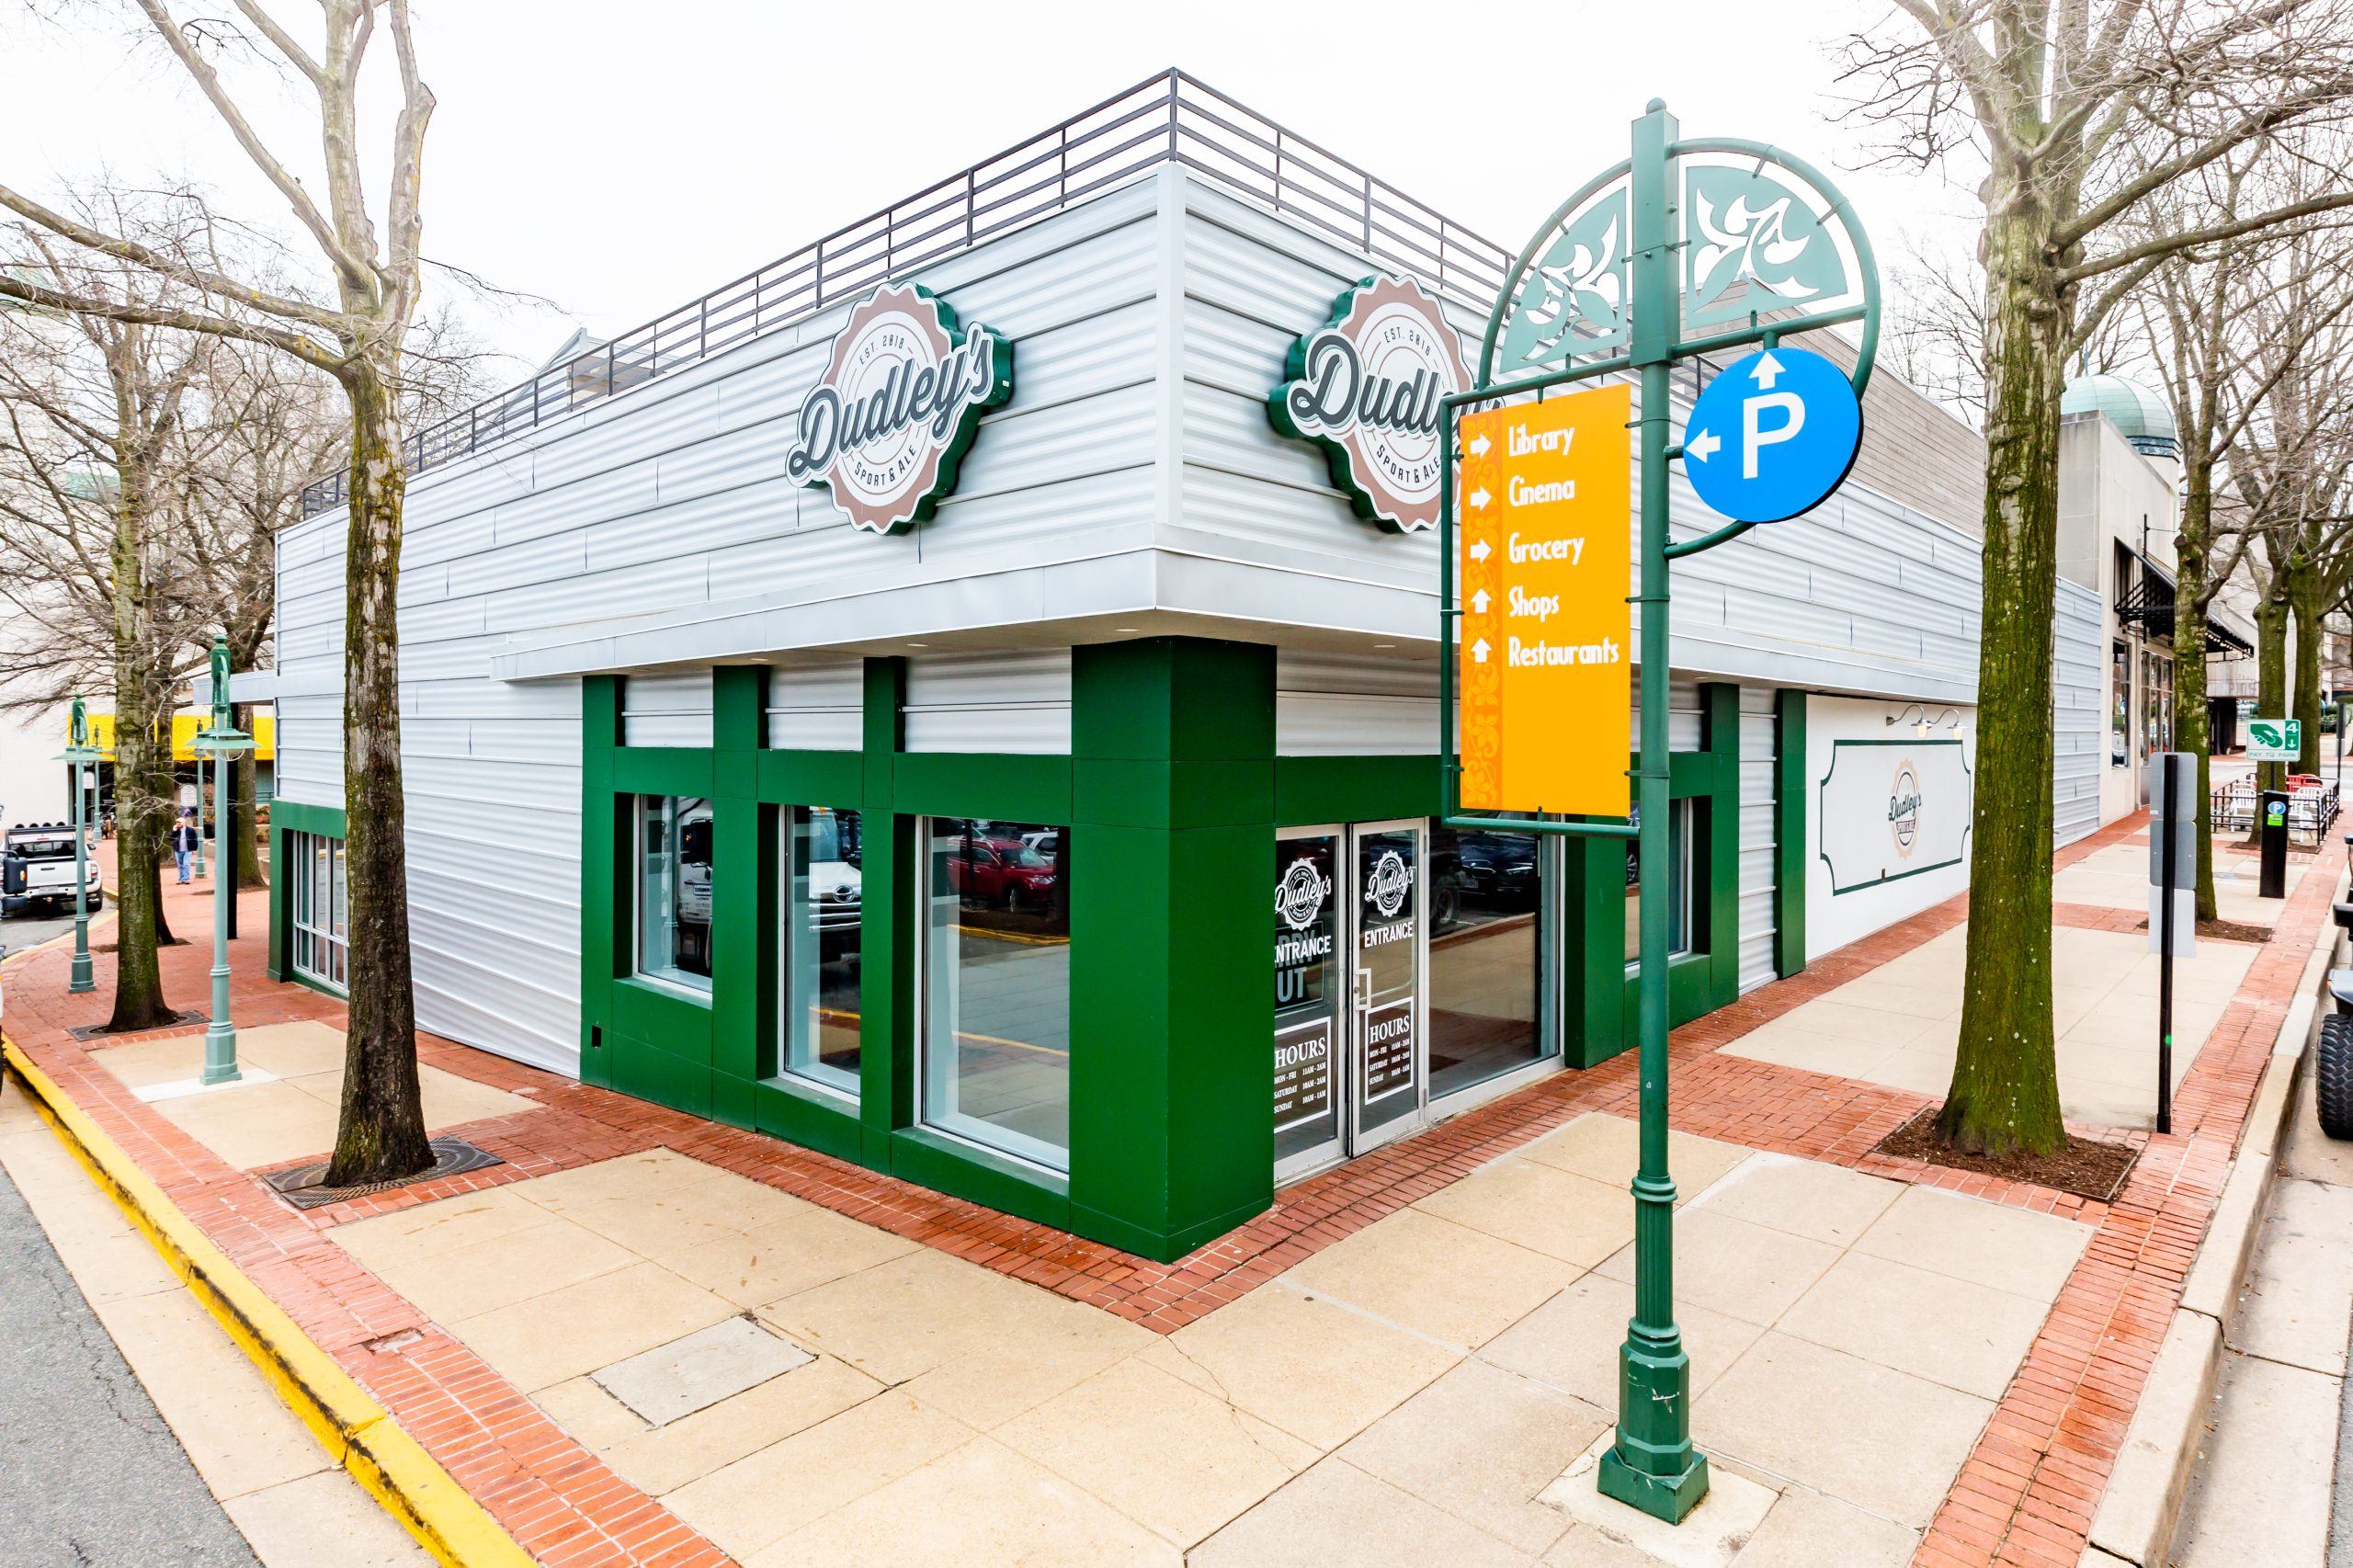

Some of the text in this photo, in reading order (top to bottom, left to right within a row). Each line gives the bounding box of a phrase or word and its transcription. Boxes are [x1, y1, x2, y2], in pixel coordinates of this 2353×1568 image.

[1383, 326, 1404, 344] EST.
[858, 343, 879, 365] EST.
[789, 329, 990, 476] Dudley's
[1508, 423, 1575, 457] Library
[1743, 391, 1806, 480] P
[854, 444, 916, 487] SPORT & ALE
[1376, 444, 1440, 484] SPORT & ALE
[1508, 475, 1575, 507] Cinema
[1508, 531, 1586, 566] Grocery
[1508, 585, 1560, 623] Shops
[1508, 636, 1620, 668] Restaurants
[2285, 722, 2299, 733] 4
[1888, 792, 1921, 822] Dudley's
[2273, 802, 2282, 814] P
[1275, 874, 1332, 914] Dudley's
[1365, 865, 1414, 903] Dudley's
[1275, 935, 1332, 965] NTRANCE
[1364, 921, 1414, 949] ENTRANCE
[1370, 1015, 1410, 1044] HOURS
[1275, 1037, 1326, 1069] HOURS
[1370, 1059, 1388, 1073] SATURDAY
[1274, 1074, 1286, 1085] MON
[1274, 1085, 1298, 1099] SATURDAY
[1274, 1100, 1292, 1114] SUNDAY
